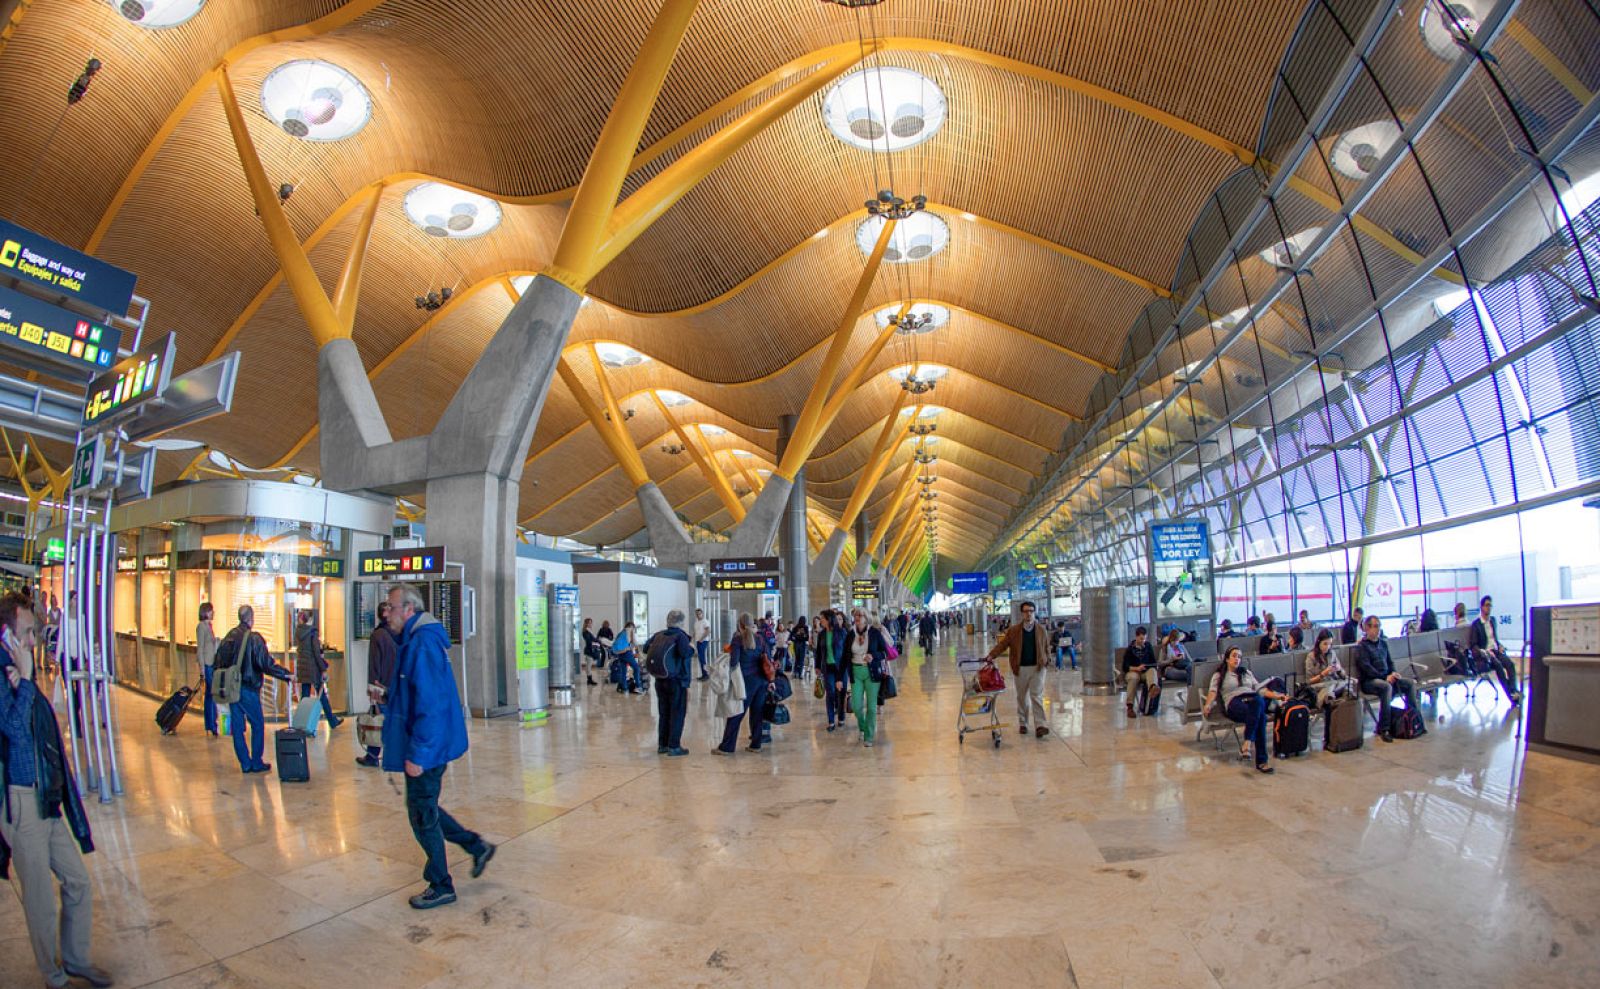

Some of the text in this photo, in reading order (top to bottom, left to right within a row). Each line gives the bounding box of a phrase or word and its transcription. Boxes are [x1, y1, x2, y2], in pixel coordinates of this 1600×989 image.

[21, 247, 86, 281] Baggage and way out
[18, 259, 81, 292] Equipajes y salida
[78, 323, 87, 337] H
[101, 350, 110, 364] U
[1162, 549, 1200, 559] POR LEY
[225, 555, 268, 570] ROLEX
[425, 557, 431, 568] K
